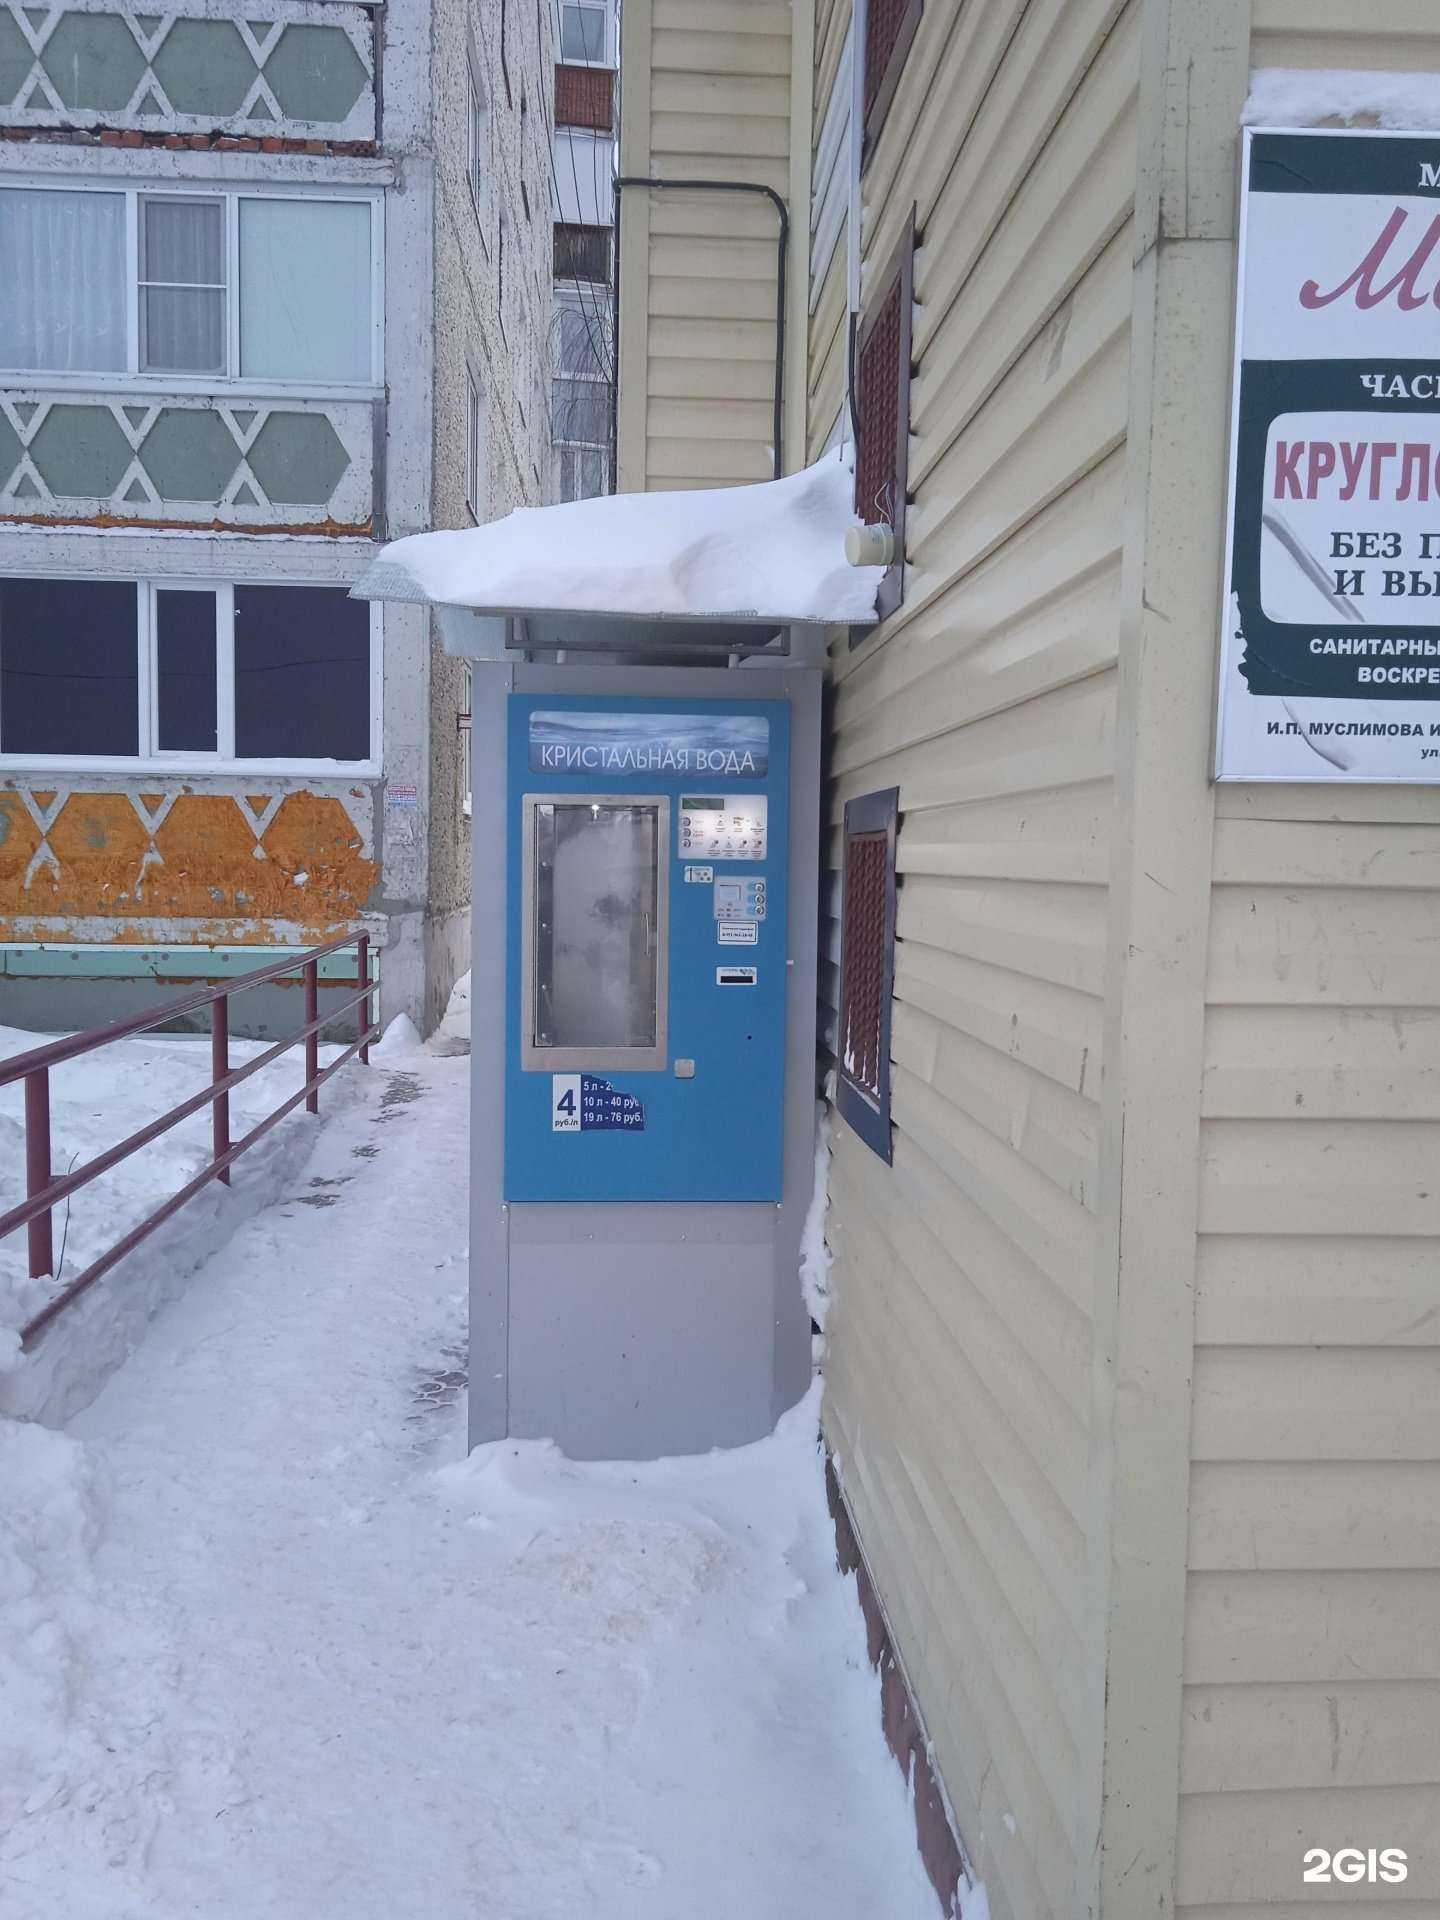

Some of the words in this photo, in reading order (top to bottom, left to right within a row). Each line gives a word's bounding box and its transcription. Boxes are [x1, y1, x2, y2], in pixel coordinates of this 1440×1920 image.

[1360, 374, 1440, 399] ЧАС
[1273, 441, 1440, 501] КРУГЛ
[1329, 532, 1402, 558] БЕЗ
[1333, 569, 1365, 596] И
[1308, 722, 1424, 737] МУСЛИМОВА
[541, 745, 689, 770] КРИСТАЛЬНАЯ
[696, 750, 755, 774] ВОДА
[583, 1081, 589, 1091] 5
[605, 1081, 614, 1091] 2
[557, 1089, 577, 1116] 4
[583, 1096, 594, 1106] 10
[596, 1098, 603, 1106] л
[610, 1096, 622, 1106] 40
[583, 1112, 594, 1122] 19
[596, 1114, 603, 1122] л
[610, 1112, 622, 1122] 76
[623, 1112, 643, 1124] руб.
